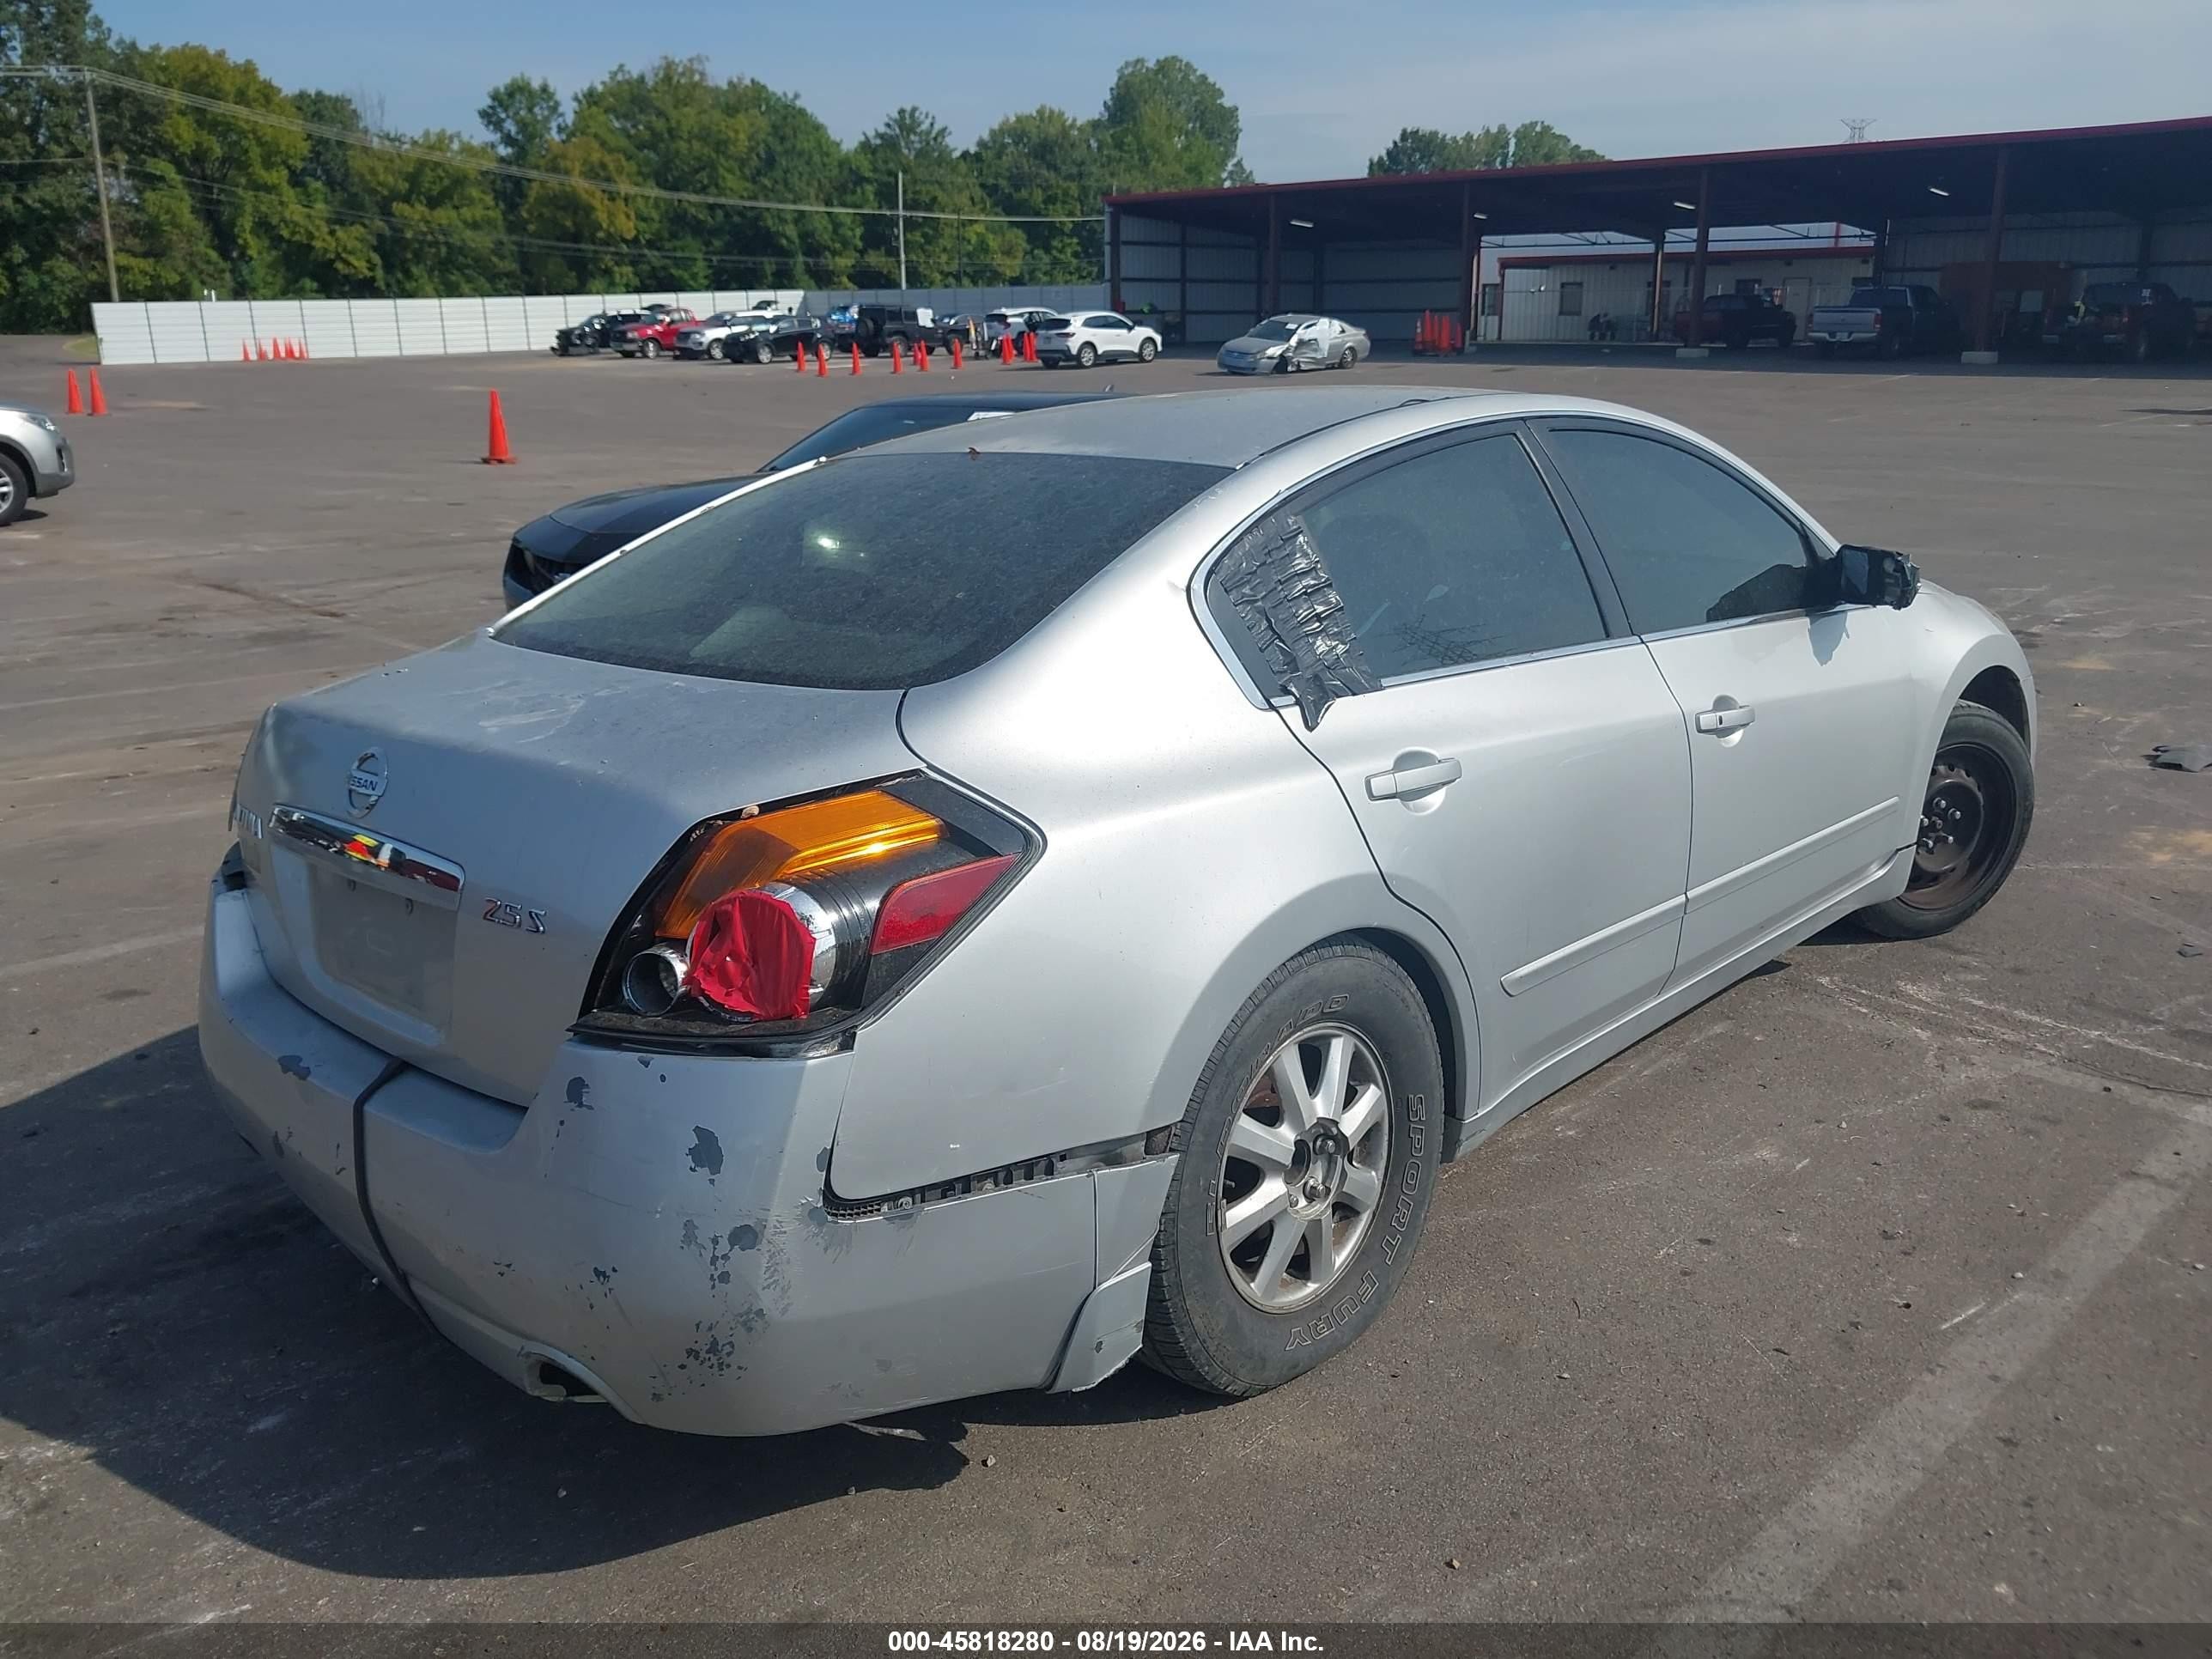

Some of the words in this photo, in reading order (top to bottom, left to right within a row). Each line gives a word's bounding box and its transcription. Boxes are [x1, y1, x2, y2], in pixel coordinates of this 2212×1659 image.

[525, 908, 546, 934] S
[1381, 1094, 1425, 1266] SPORT
[1285, 1270, 1379, 1352] FURY
